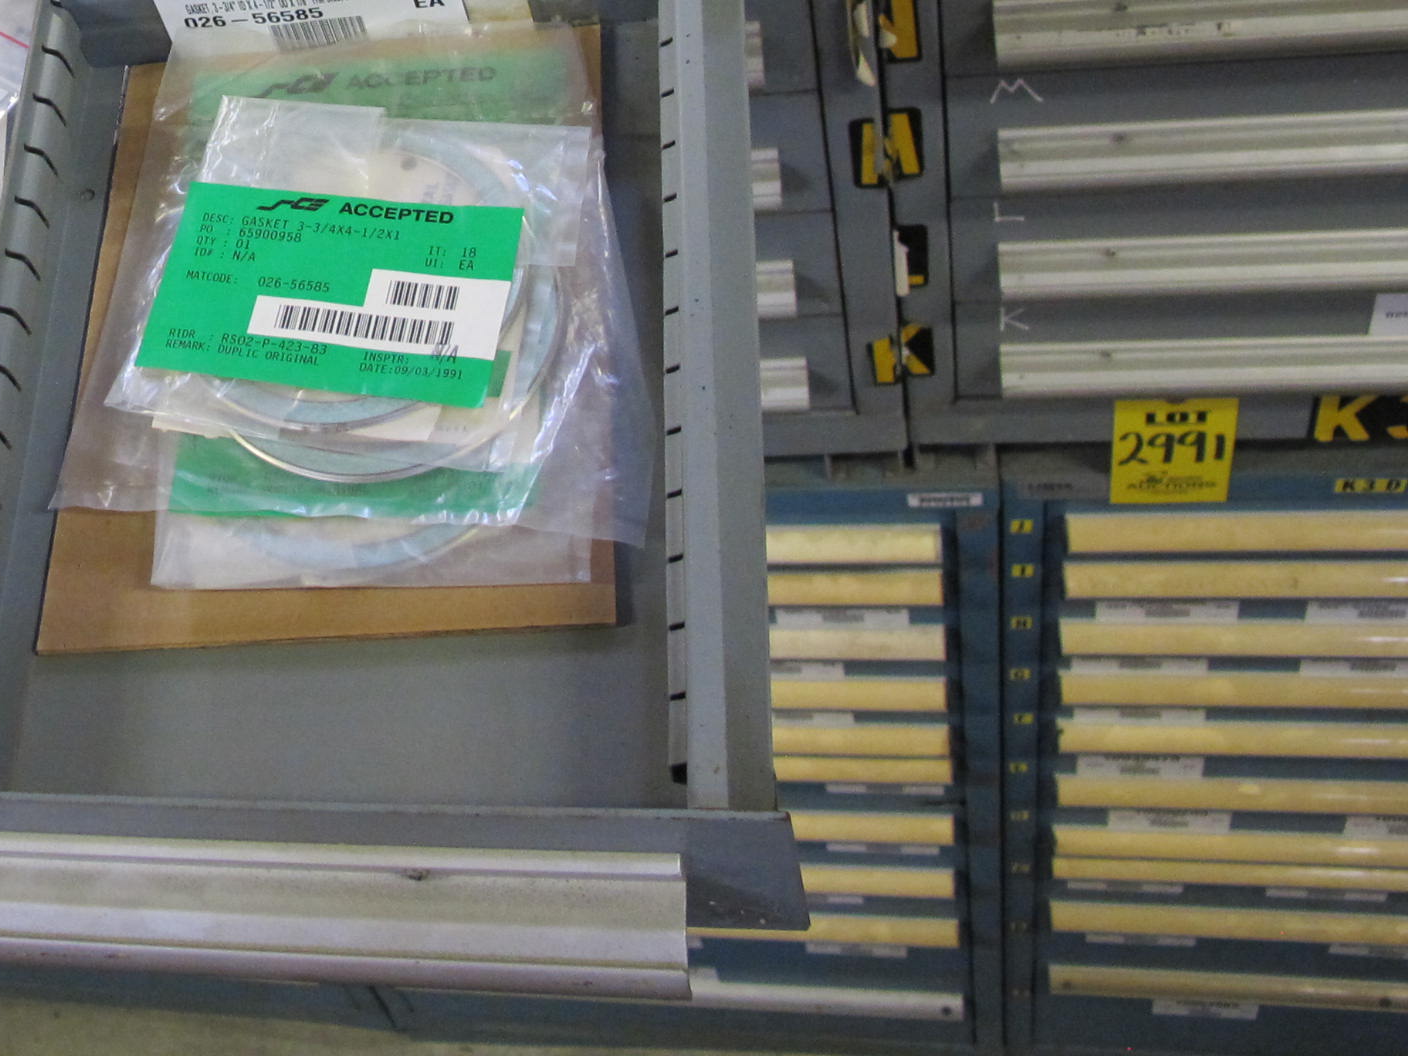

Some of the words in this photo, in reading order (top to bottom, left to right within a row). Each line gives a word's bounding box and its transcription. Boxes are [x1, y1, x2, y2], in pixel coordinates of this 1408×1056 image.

[346, 66, 497, 90] ACCEPTED
[339, 202, 455, 224] ACCEPTED
[202, 212, 234, 226] DESC:
[241, 215, 289, 230] GASKET
[297, 221, 400, 241] 3-3/4X4-1/2X1
[196, 235, 216, 246] QTY
[239, 228, 303, 243] 65900958
[232, 250, 256, 263] N/A
[461, 247, 477, 258] 18
[459, 260, 474, 271] EA
[187, 269, 239, 285] MATCODE:
[258, 277, 330, 293] 026-56585
[265, 350, 320, 367] ORIGINAL
[1145, 410, 1211, 425] LOT
[1118, 430, 1226, 466] 2991
